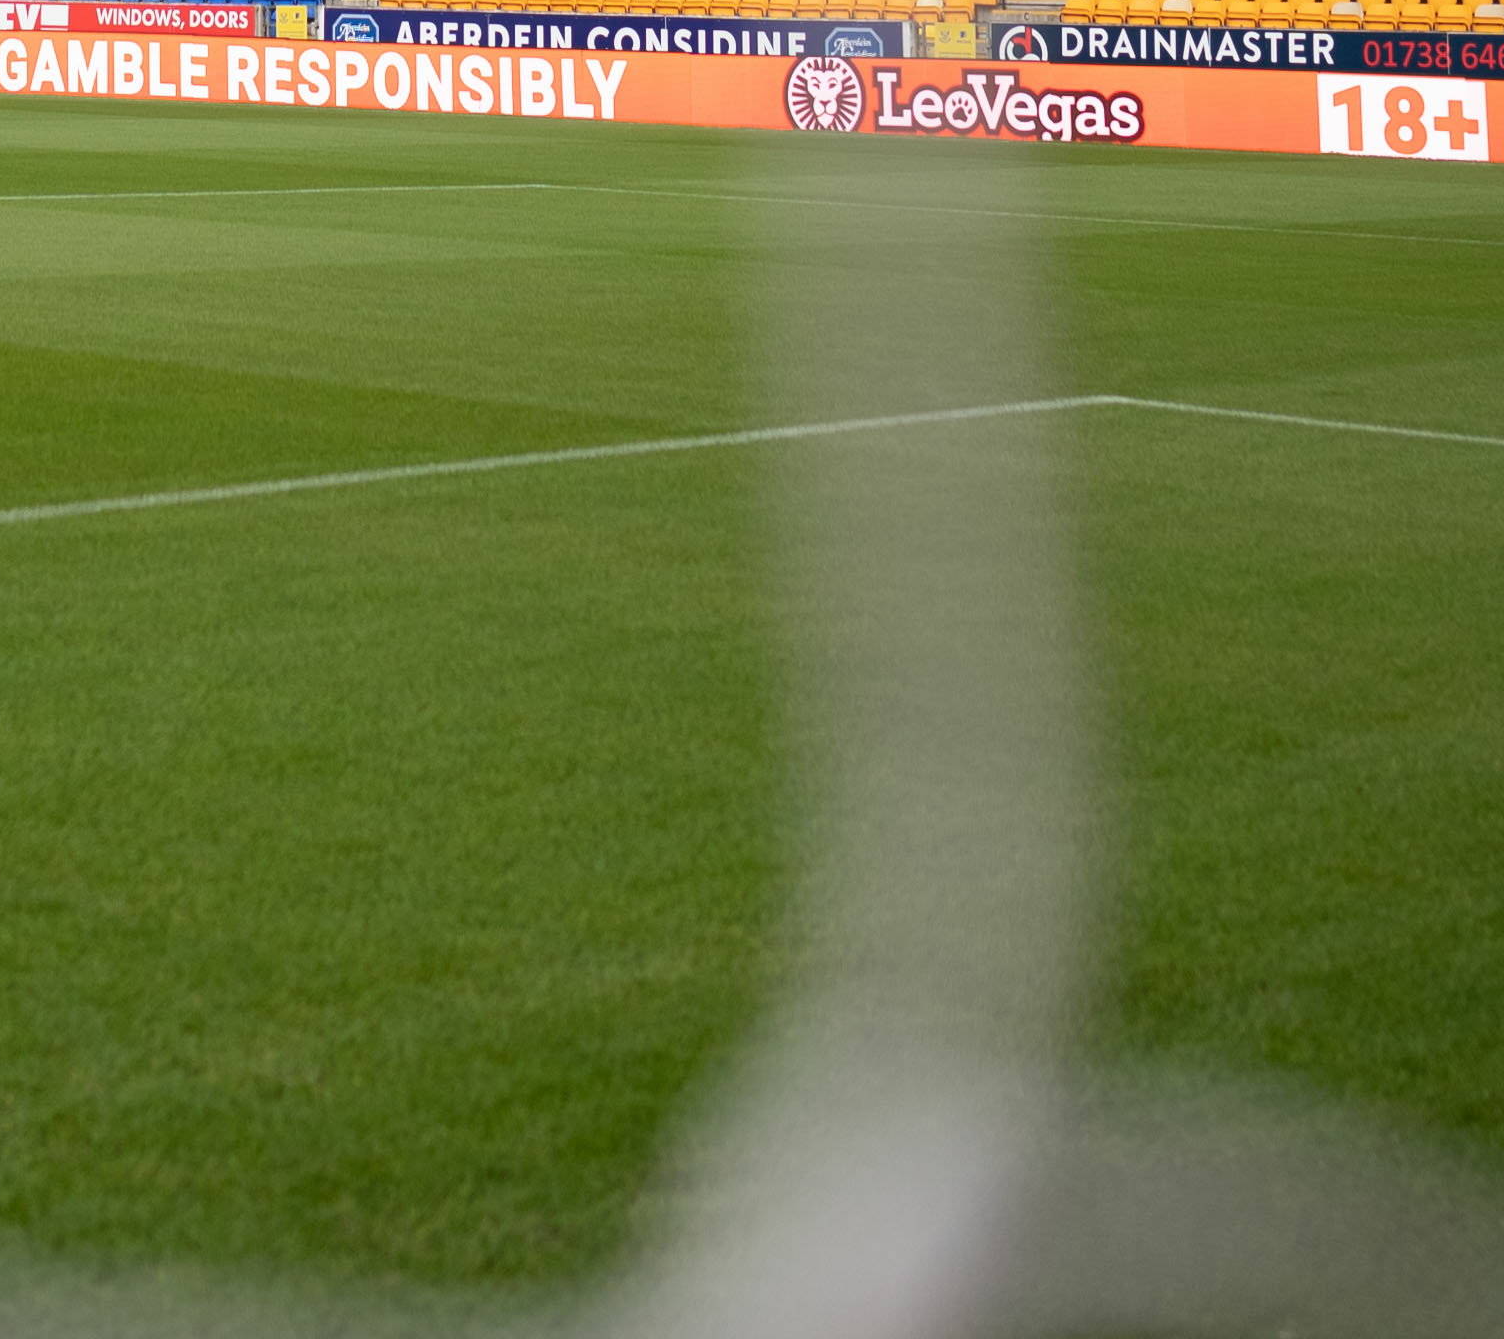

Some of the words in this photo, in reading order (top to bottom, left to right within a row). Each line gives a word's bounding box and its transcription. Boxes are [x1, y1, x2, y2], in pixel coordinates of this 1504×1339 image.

[95, 6, 182, 31] WINDOWS,
[187, 8, 249, 31] DOORS
[396, 20, 572, 49] ABERDEEN
[587, 25, 806, 57] CONSIDINE
[1061, 27, 1335, 66] DRAINMASTER
[1363, 39, 1452, 69] 01738
[227, 44, 627, 119] RESPONSIBLY
[874, 68, 1143, 142] LeoVegas
[1330, 83, 1480, 156] 18+
